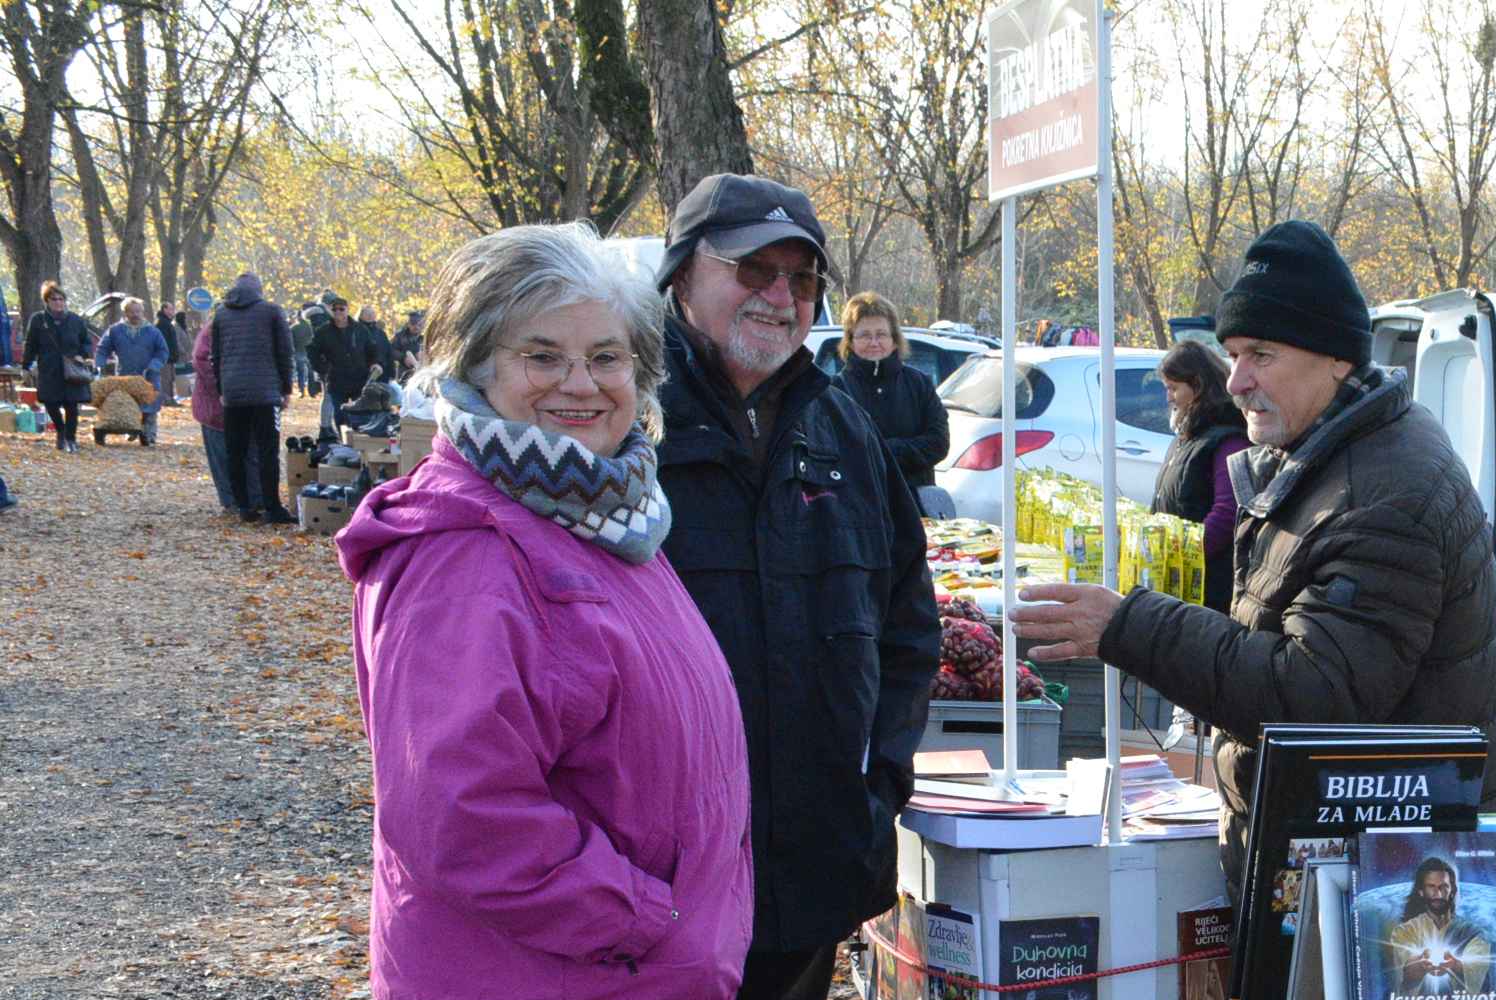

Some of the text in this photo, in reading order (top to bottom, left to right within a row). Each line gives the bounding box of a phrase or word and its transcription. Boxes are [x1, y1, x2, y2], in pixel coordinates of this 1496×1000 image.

[1326, 775, 1430, 802] BIBLIJA
[1317, 804, 1432, 823] ZA MLADE
[928, 919, 968, 947] Zdravlje
[929, 944, 972, 966] wellness
[1012, 944, 1088, 963] Duhovna
